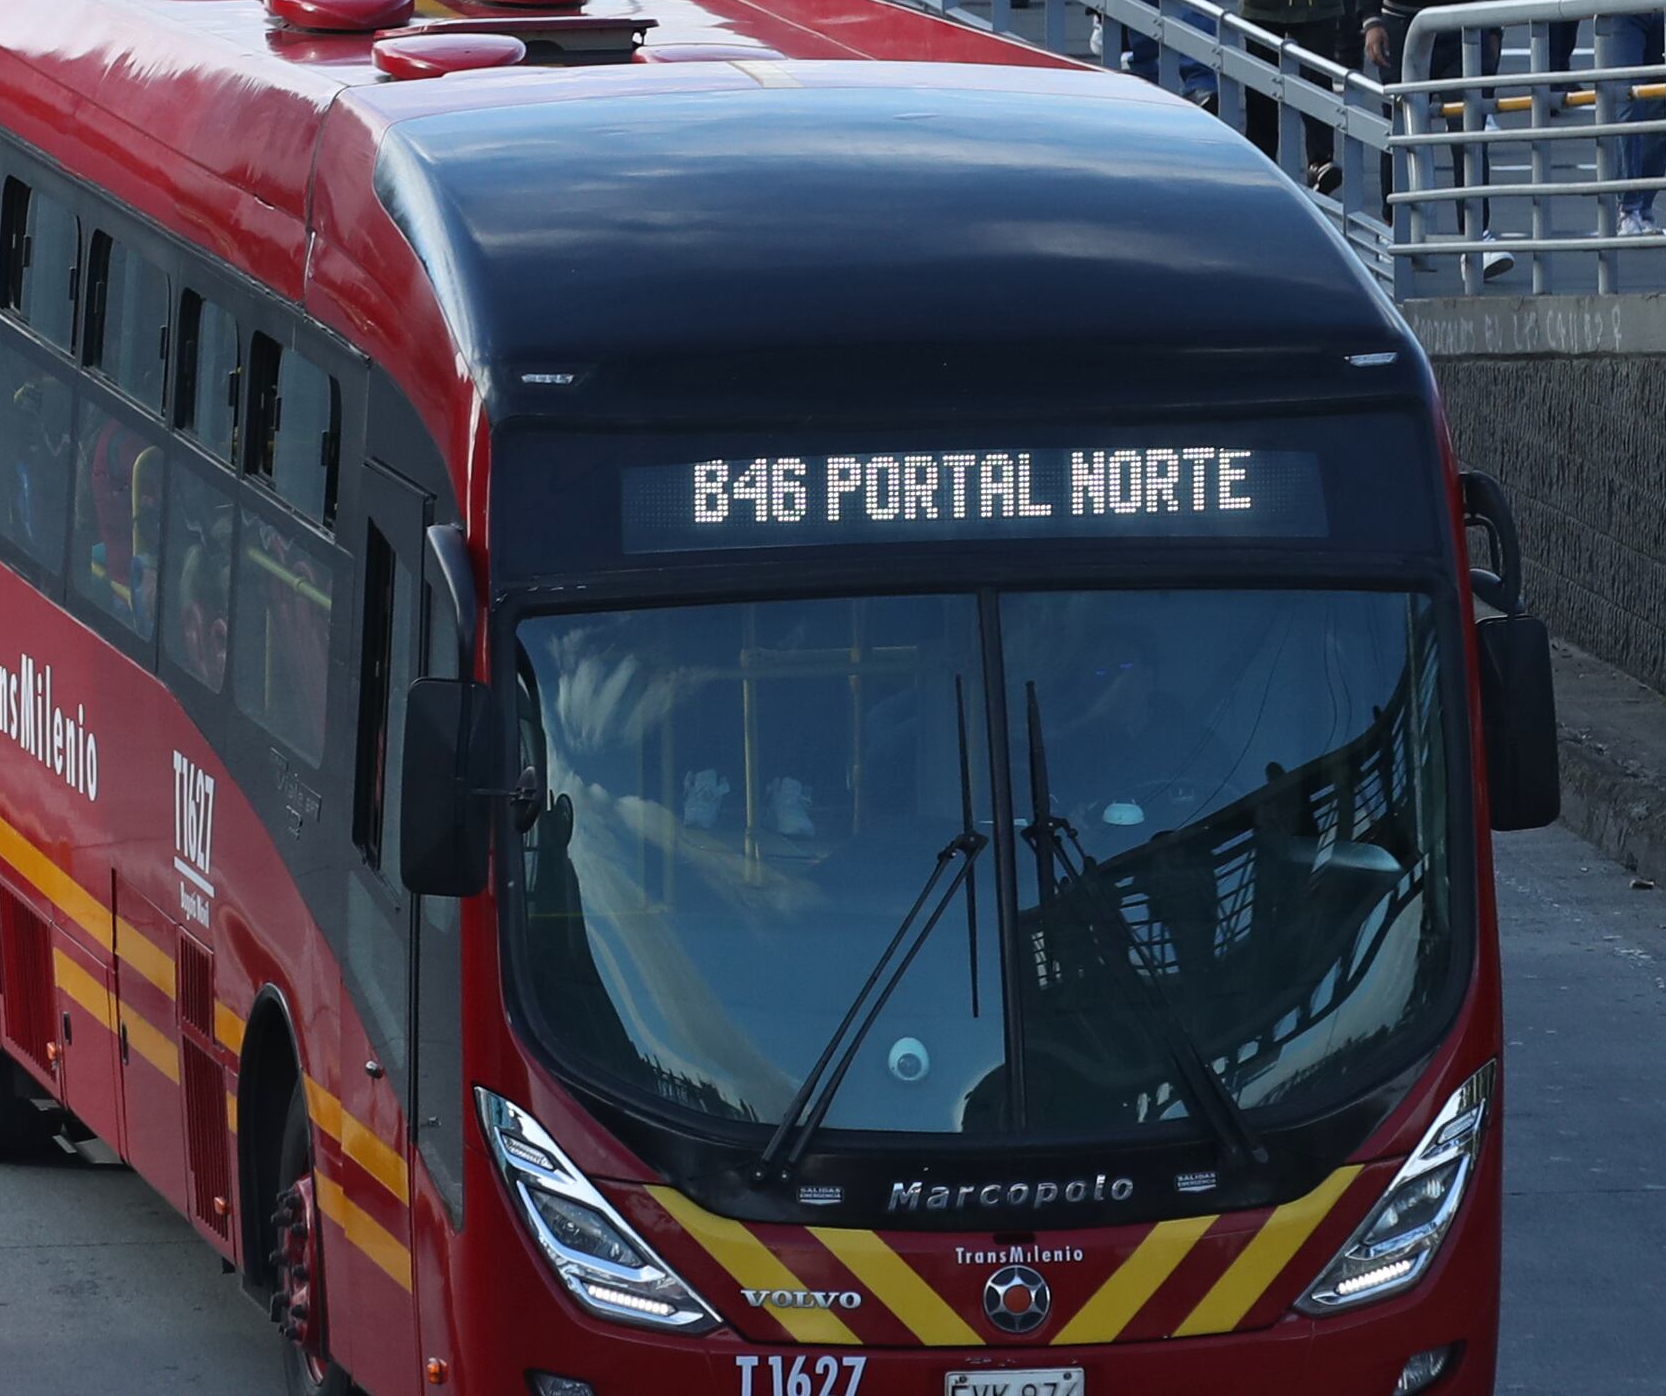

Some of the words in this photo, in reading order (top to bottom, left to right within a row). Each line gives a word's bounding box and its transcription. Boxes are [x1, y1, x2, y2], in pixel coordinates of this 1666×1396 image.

[694, 457, 807, 522] B46
[826, 452, 1053, 522] PORTAL
[1071, 446, 1252, 516] NORTE
[173, 749, 215, 875] T1627
[887, 1173, 1135, 1213] Marcopolo
[955, 1246, 1085, 1265] TransMilenio
[740, 1289, 863, 1311] VOLVO
